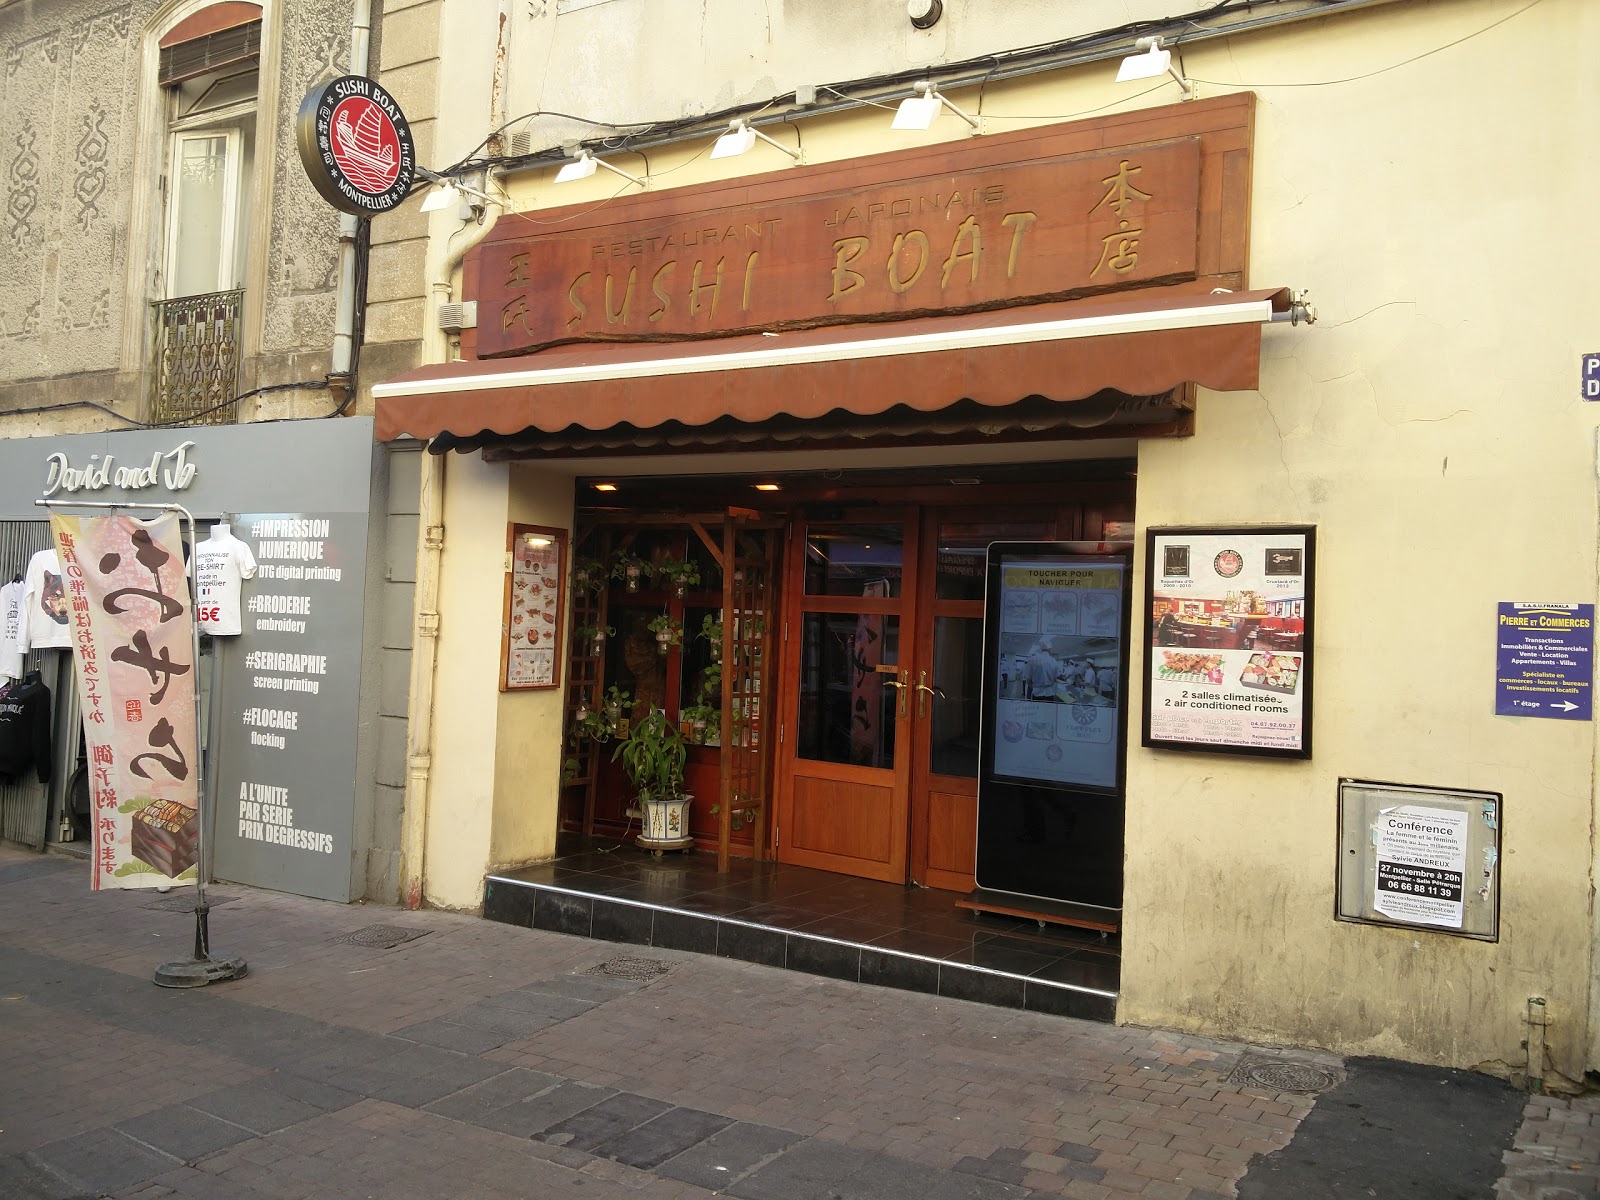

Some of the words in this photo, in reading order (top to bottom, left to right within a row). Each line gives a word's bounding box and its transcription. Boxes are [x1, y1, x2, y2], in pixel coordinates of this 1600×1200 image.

[336, 80, 368, 98] SUSHI
[373, 88, 401, 122] BOAT
[338, 178, 394, 208] MONTPELLIER
[592, 218, 782, 260] RESTAURANT
[824, 185, 1004, 226] JAPONAIS
[1088, 160, 1152, 280] 本店
[567, 251, 758, 328] SUSHI
[826, 211, 1038, 302] BOAT
[43, 452, 115, 496] David
[115, 452, 164, 488] and
[164, 440, 198, 490] Jo
[252, 520, 329, 538] #IMPRESSION
[258, 541, 324, 561] NUMERIQUE
[258, 565, 274, 578] DTG
[276, 566, 304, 580] digital
[305, 567, 342, 582] printing
[1070, 570, 1094, 578] POUR
[197, 580, 226, 588] ontpellier
[248, 595, 310, 614] #BRODERIE
[256, 618, 306, 634] embroidery
[1500, 615, 1528, 626] PIERRE
[1540, 616, 1590, 628] COMMERCES
[1544, 644, 1588, 652] Commerciales
[246, 651, 326, 674] #SERIGRAPHIE
[254, 676, 282, 690] screen
[284, 678, 320, 694] printing
[1182, 690, 1188, 698] 2
[1191, 691, 1220, 700] salles
[1521, 700, 1540, 708] étage
[1164, 698, 1171, 706] 2
[1174, 700, 1187, 708] air
[1190, 700, 1251, 711] conditioned
[1254, 705, 1288, 714] rooms
[243, 708, 298, 730] #FLOCAGE
[251, 732, 286, 750] flocking
[240, 782, 248, 800] A
[250, 782, 288, 806] L'UNITE
[240, 800, 260, 822] PAR
[262, 802, 293, 827] SERIE
[1388, 819, 1453, 835] Conférence
[238, 820, 264, 841] PRIX
[266, 824, 332, 854] DEGRESSIFS
[1396, 831, 1416, 839] femme
[1433, 836, 1458, 844] féminin
[1414, 857, 1450, 868] ANDREUX
[1380, 872, 1411, 882] Montpellier
[1432, 880, 1460, 889] Pétrarque
[1393, 866, 1435, 878] novembre
[1444, 874, 1460, 882] 20h
[1401, 883, 1412, 891] 66
[1414, 885, 1425, 893] 88
[1428, 887, 1437, 895] 11
[1440, 889, 1451, 897] 39
